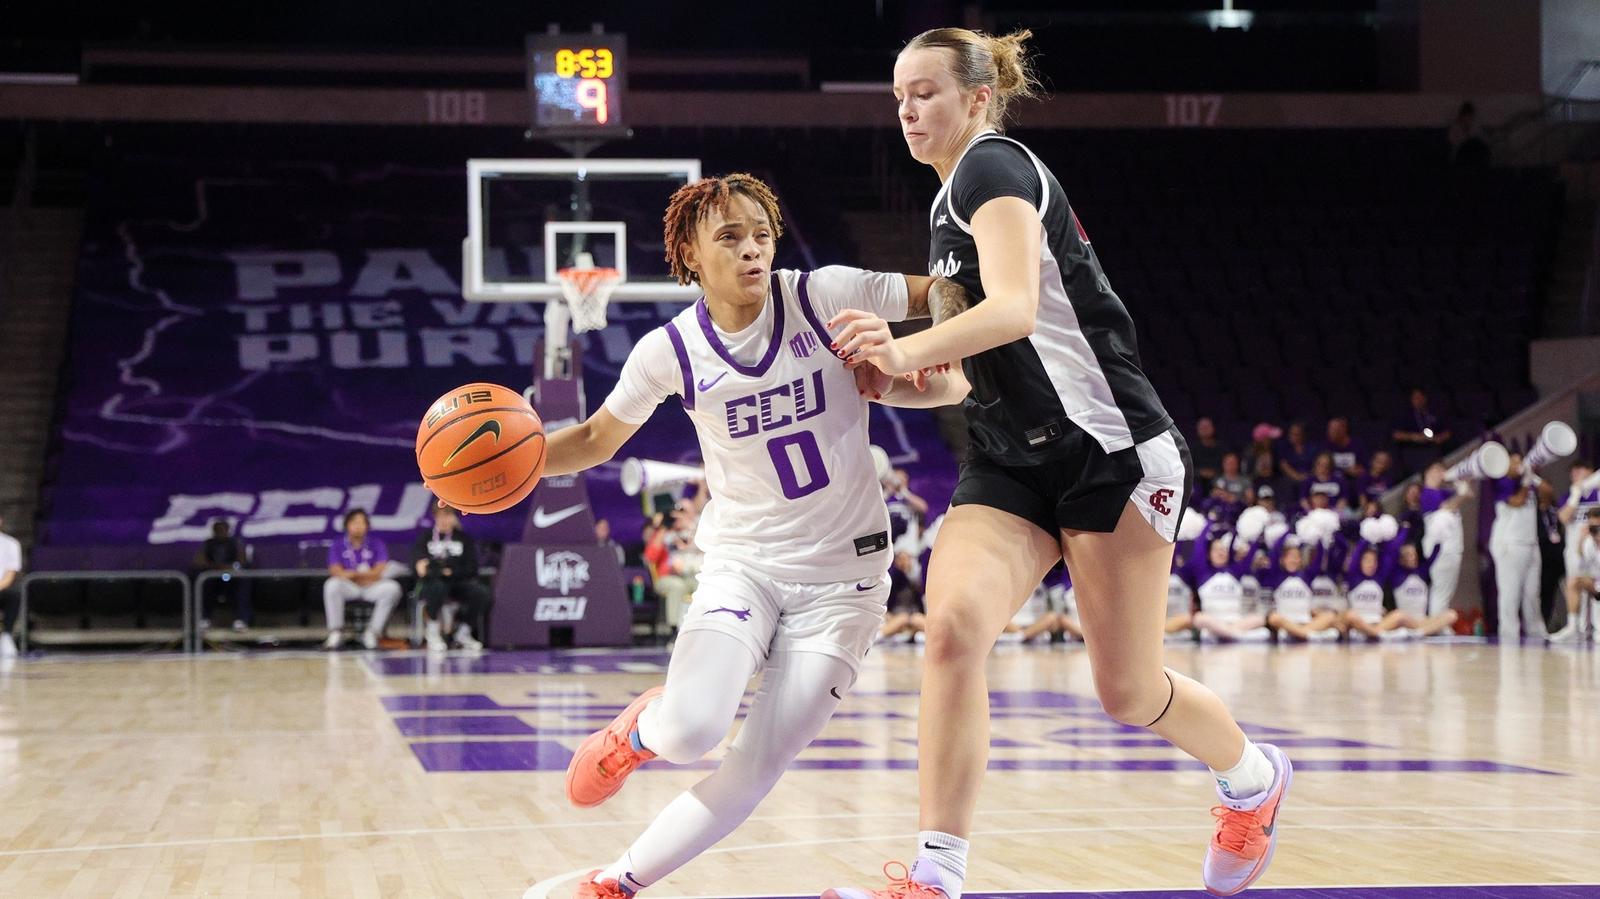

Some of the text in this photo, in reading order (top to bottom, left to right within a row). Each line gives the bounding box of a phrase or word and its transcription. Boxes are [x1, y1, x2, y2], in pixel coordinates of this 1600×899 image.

[555, 48, 614, 78] 8:53
[423, 90, 487, 124] 108
[577, 78, 608, 124] 9
[1164, 94, 1222, 127] 107
[226, 300, 404, 331] THE
[427, 391, 492, 429] ELITE
[725, 369, 826, 438] GCU
[767, 430, 830, 500] 0
[472, 471, 507, 497] GCU
[147, 482, 433, 544] GCU
